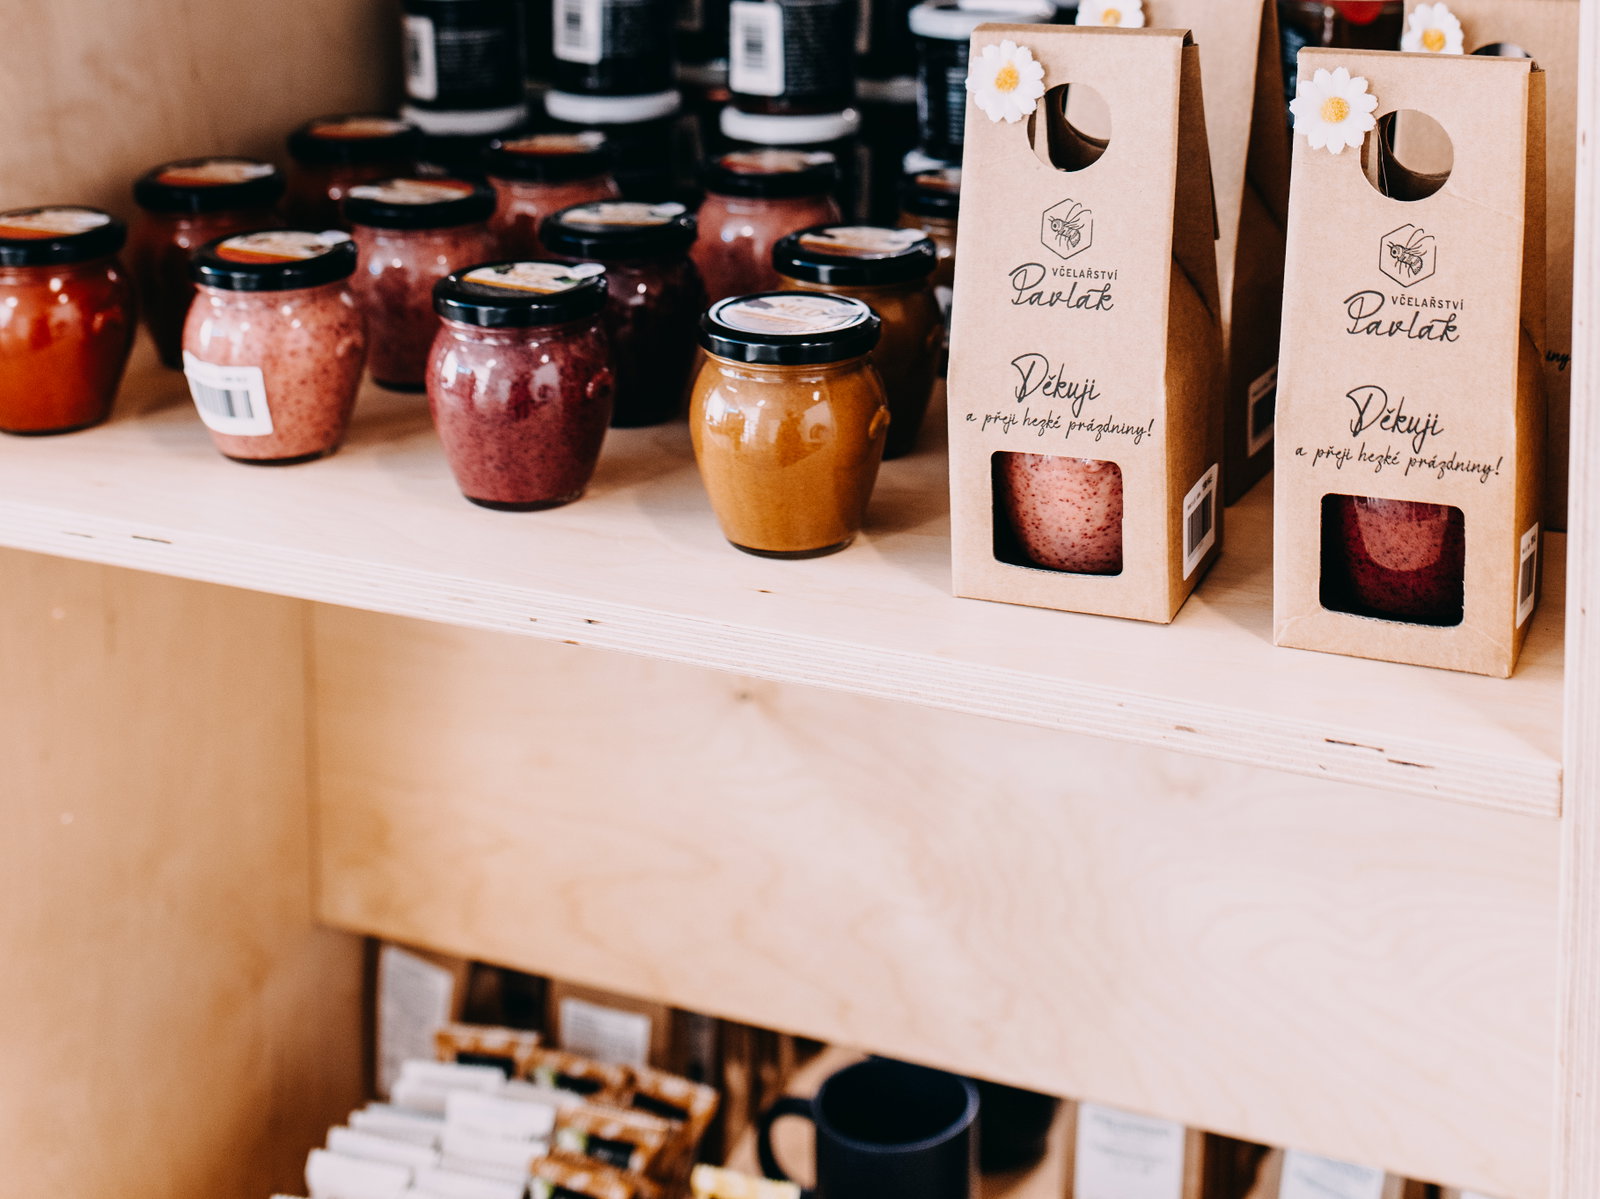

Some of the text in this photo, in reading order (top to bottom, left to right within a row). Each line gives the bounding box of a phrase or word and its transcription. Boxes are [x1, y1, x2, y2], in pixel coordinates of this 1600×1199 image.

[1051, 265, 1118, 281] VČELAŘSTVÍ
[1391, 293, 1464, 311] VČELAŘSTVÍ
[1011, 352, 1101, 418] Děkuji
[965, 407, 1155, 445] a přeji hezké prázdniny!
[1345, 384, 1445, 454] Děkuji
[1295, 441, 1504, 484] a přeji hezké prázdniny!
